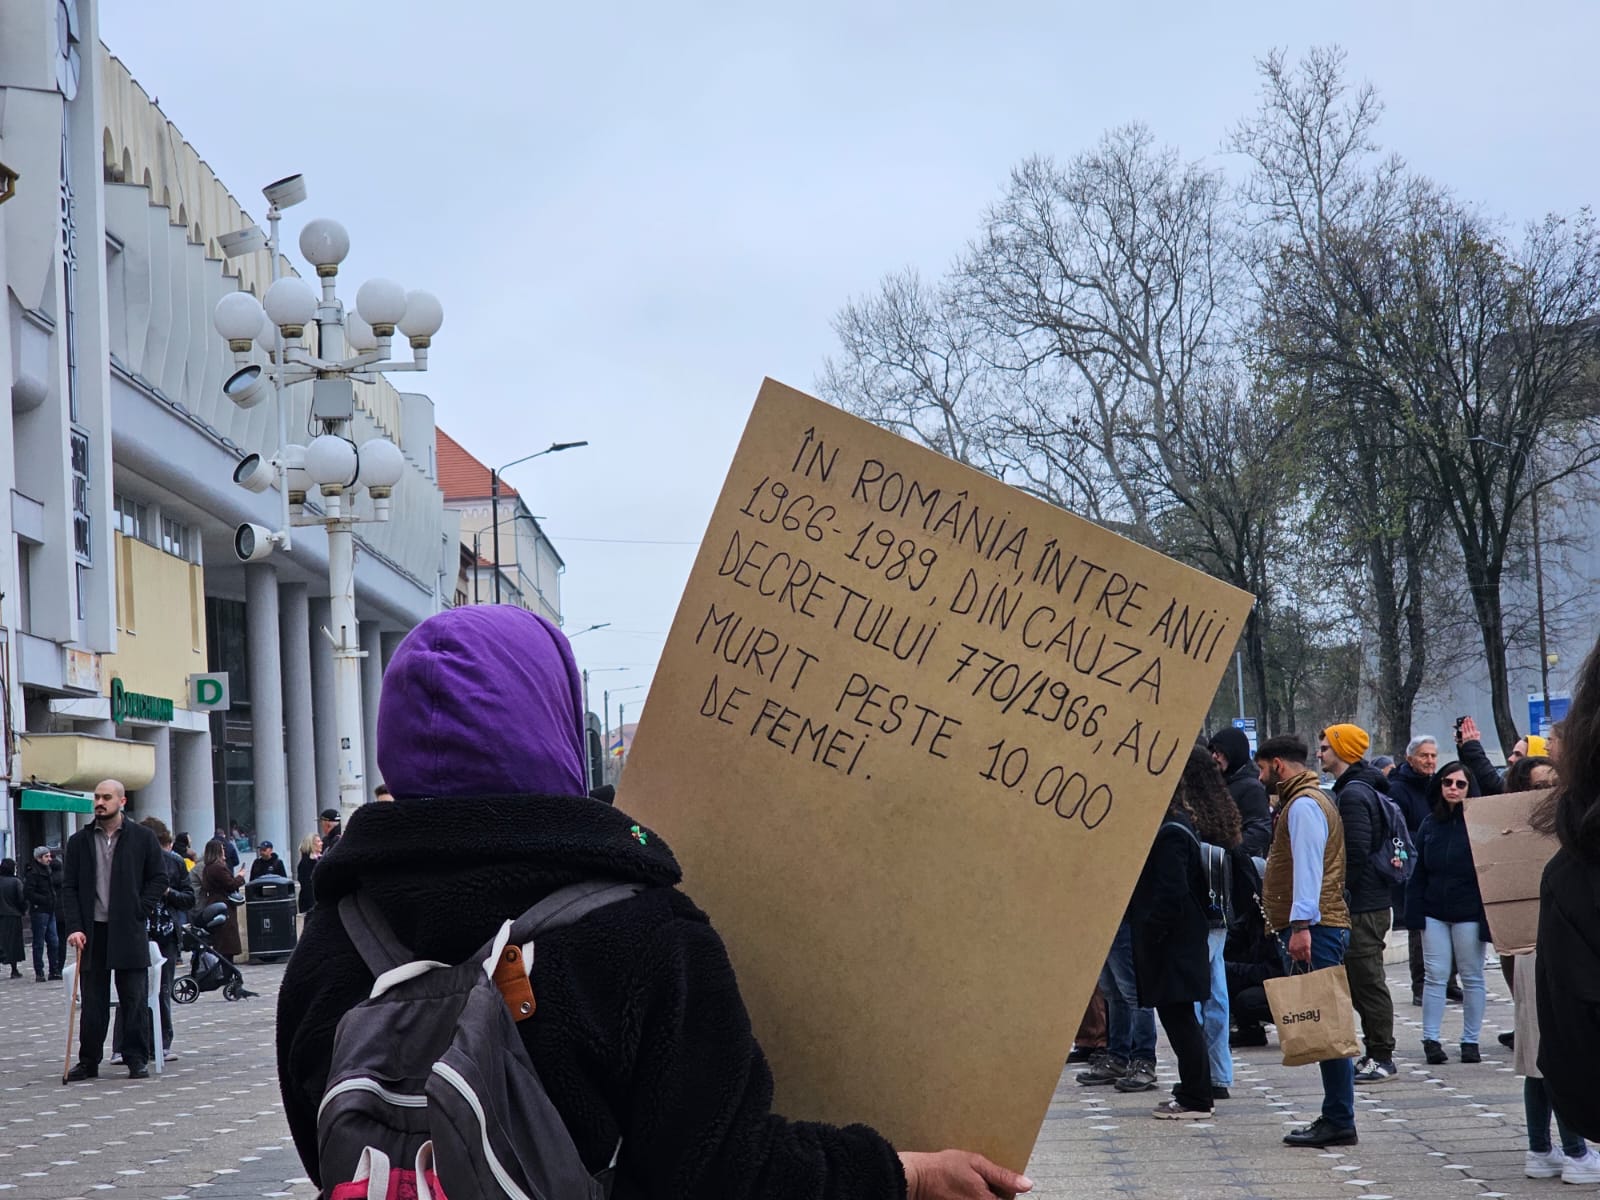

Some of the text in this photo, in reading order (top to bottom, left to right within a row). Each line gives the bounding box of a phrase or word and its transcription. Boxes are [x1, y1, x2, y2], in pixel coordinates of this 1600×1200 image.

[792, 426, 840, 483] ÎN
[1032, 538, 1149, 628] ÎNTRE
[197, 678, 223, 705] D
[700, 673, 753, 726] DE
[1022, 605, 1162, 705] CAUZA
[695, 602, 1113, 830] MURIT PESTE 10.000
[947, 643, 1108, 755] 770/1966,
[1112, 718, 1180, 777] AU
[1281, 1008, 1321, 1025] sinsay
